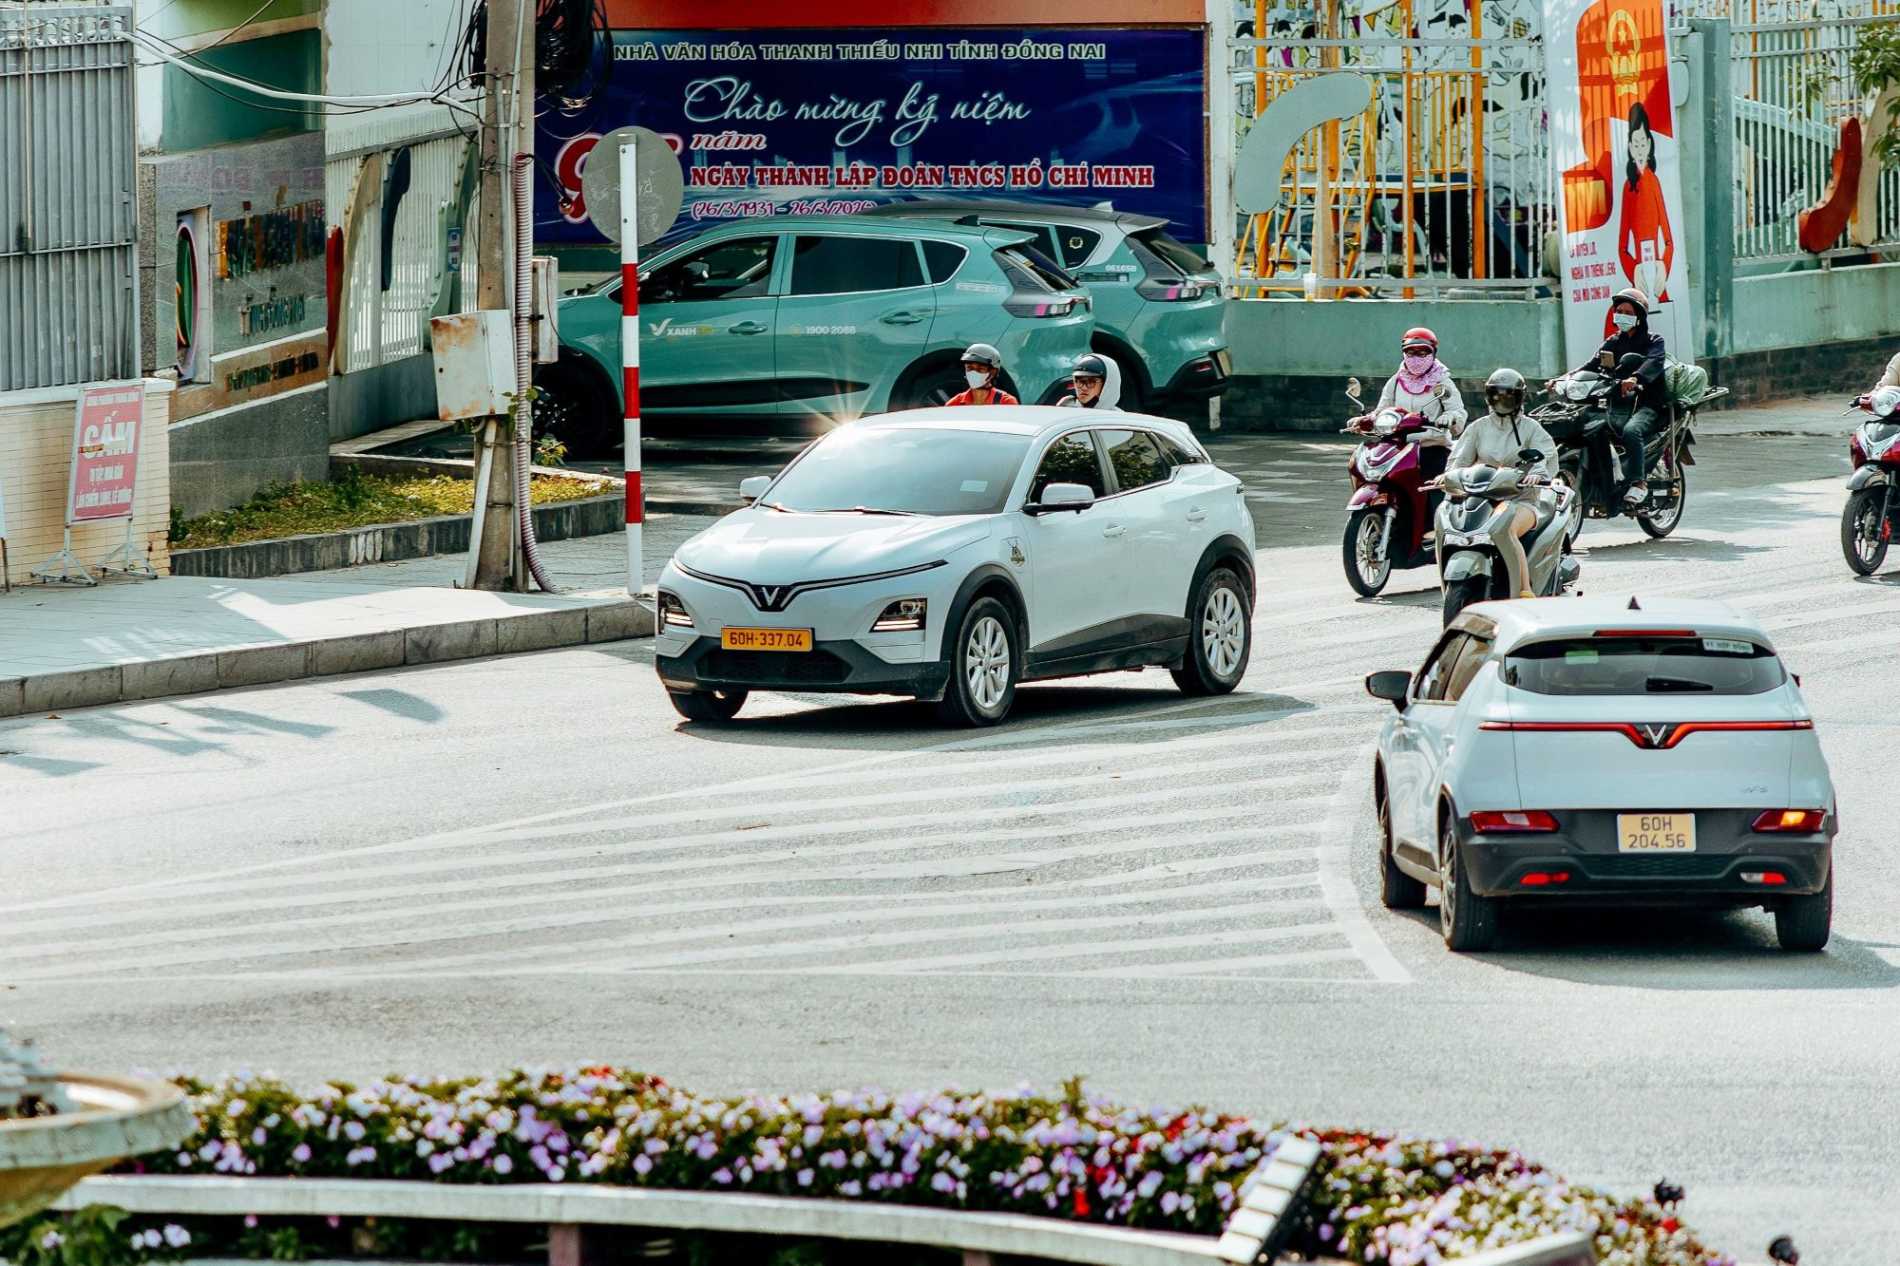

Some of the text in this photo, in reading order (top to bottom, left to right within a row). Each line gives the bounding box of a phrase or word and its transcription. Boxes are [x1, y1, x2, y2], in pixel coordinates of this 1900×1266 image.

[613, 38, 1106, 60] NHÀ VĂN HÓA THANH THIẾU NHI TỈNH ĐỒNG NAI
[684, 77, 788, 122] Chào
[794, 94, 887, 147] mừng
[950, 90, 1031, 125] niệm
[689, 131, 767, 150] năm
[690, 157, 1154, 190] NGÀY THÀNH LẬP ĐOÀN TNCS HỒ CHÍ MINH
[806, 326, 829, 335] 1900
[84, 410, 136, 459] CẤM
[729, 632, 803, 647] 60H-337.04
[1640, 816, 1673, 832] 60H
[1628, 833, 1686, 849] 204.56
